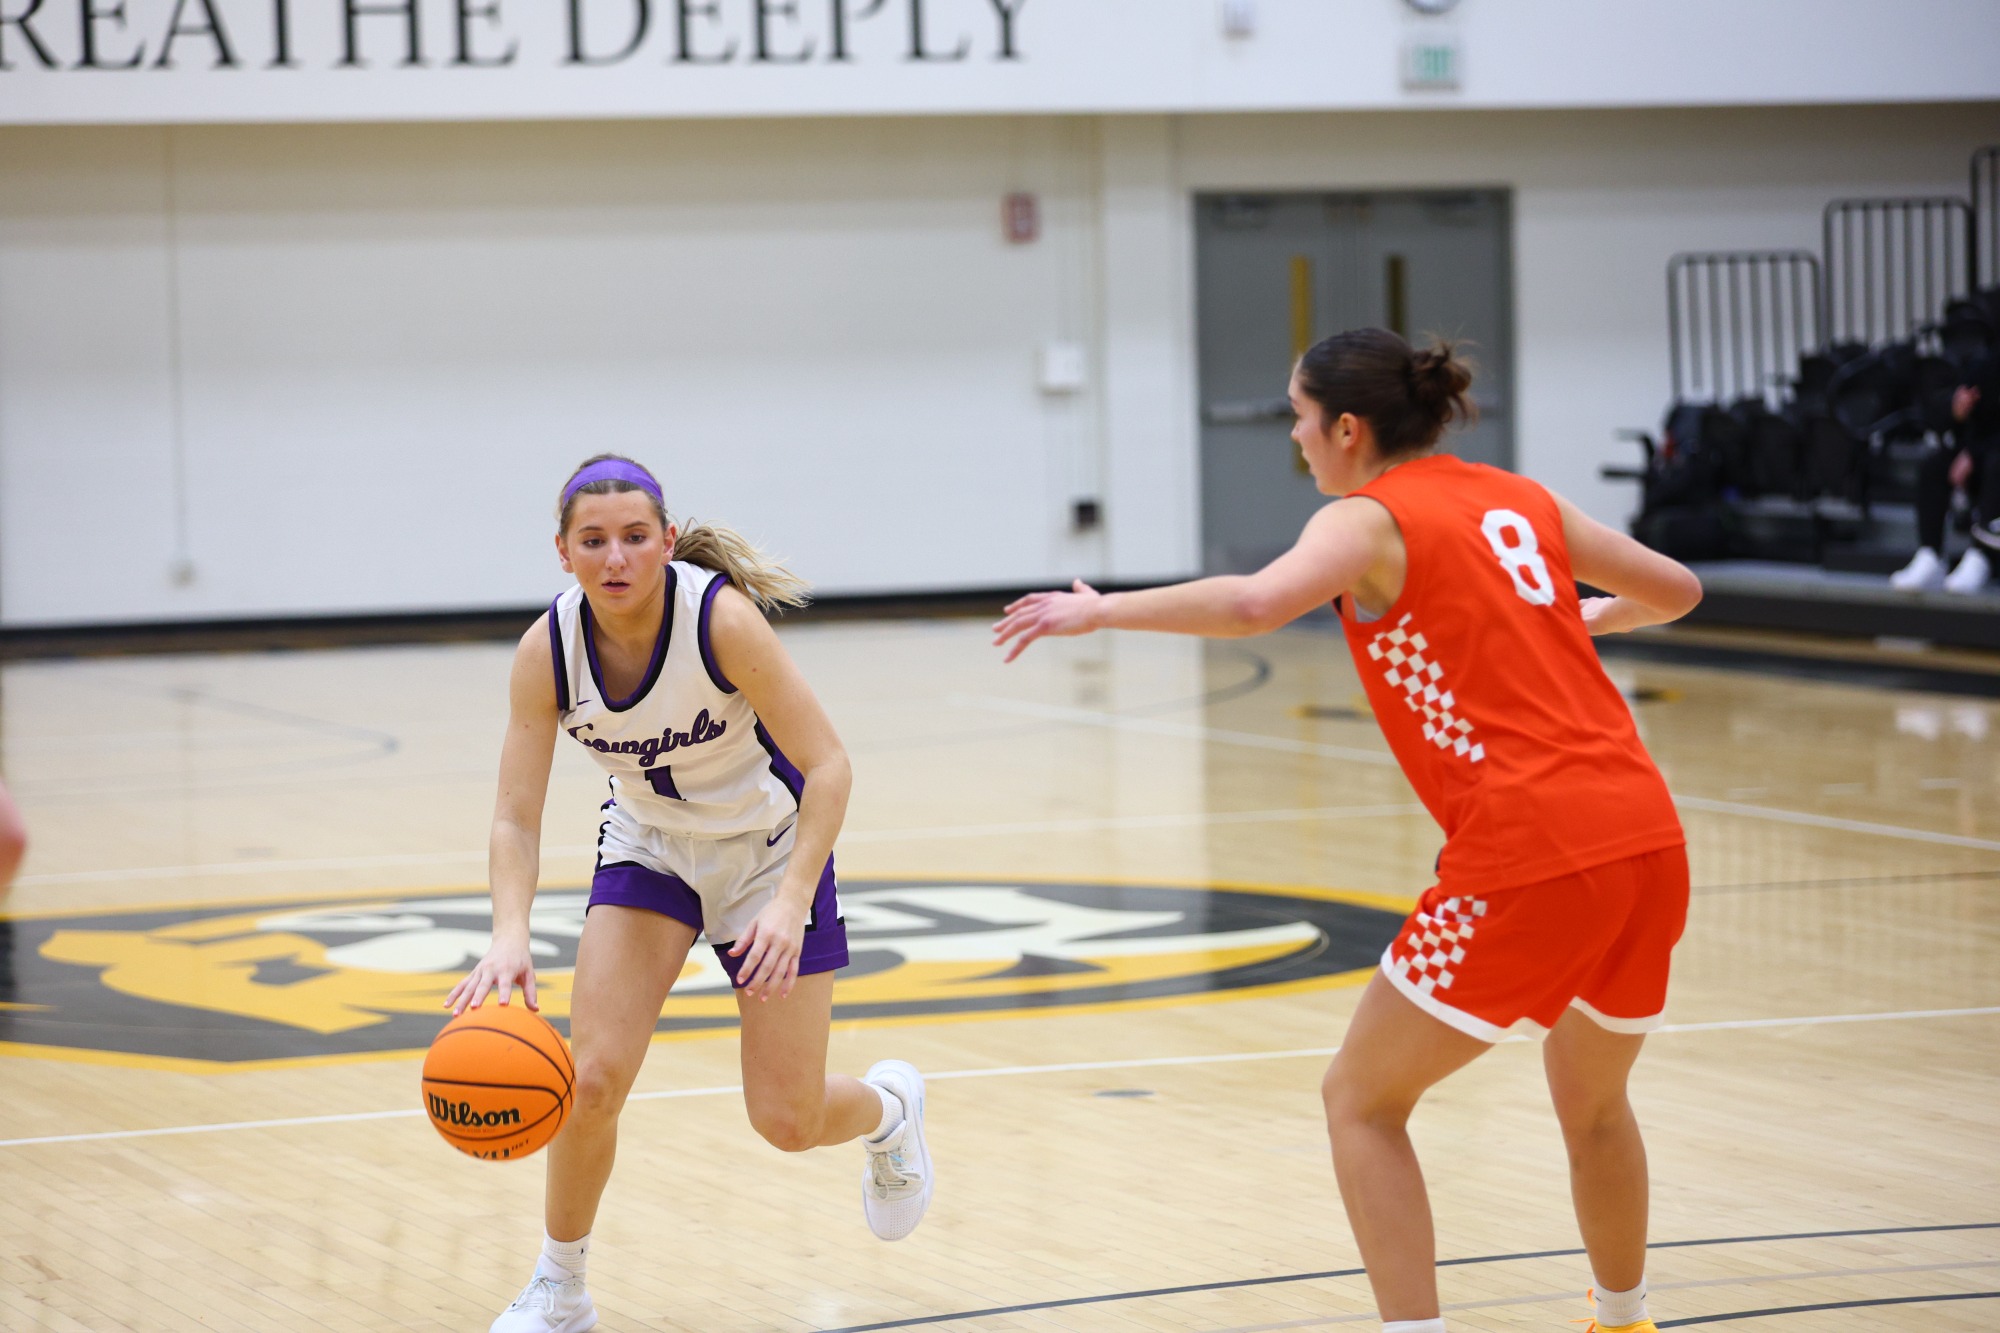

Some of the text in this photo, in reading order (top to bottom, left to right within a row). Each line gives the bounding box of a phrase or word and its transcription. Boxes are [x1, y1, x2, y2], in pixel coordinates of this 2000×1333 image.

[560, 0, 1024, 66] DEEPLY
[1480, 509, 1556, 607] 8
[567, 708, 727, 767] Cowgirls
[644, 764, 688, 802] 1
[428, 1091, 521, 1127] Wilson
